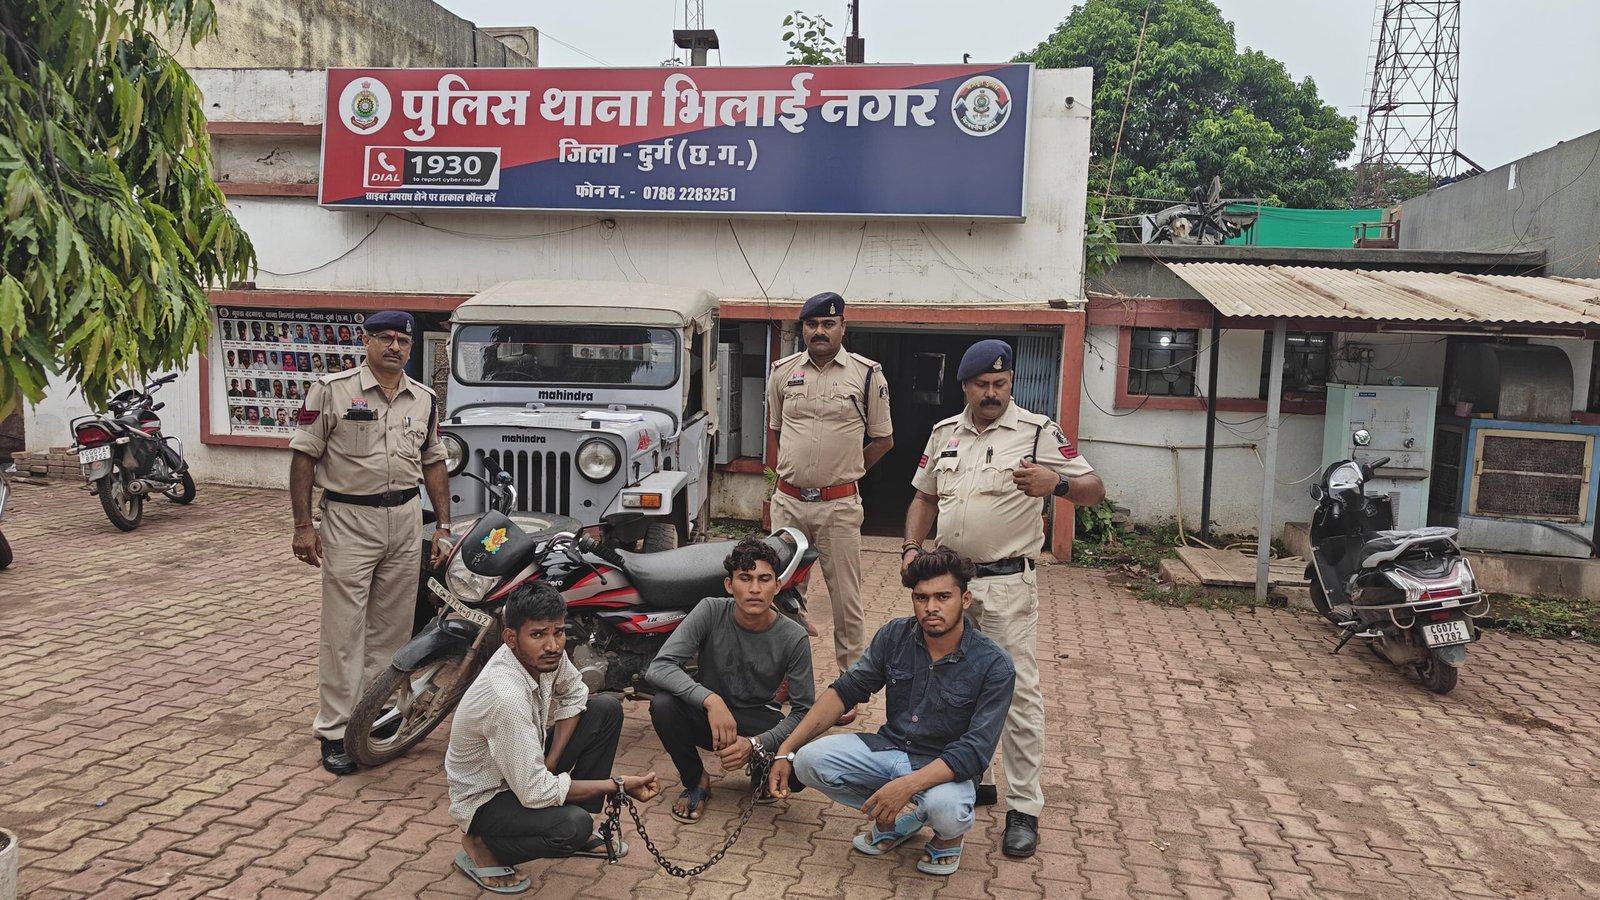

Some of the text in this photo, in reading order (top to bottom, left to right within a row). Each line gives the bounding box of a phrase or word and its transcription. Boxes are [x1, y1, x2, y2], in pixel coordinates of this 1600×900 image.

[402, 72, 940, 142] पुलिस थाना भिलाई नगर
[558, 138, 619, 164] जिला
[638, 138, 674, 172] दुर्ग
[676, 139, 758, 171] (छ.ग.)
[410, 155, 482, 175] 1930
[370, 173, 400, 182] DIAL
[365, 191, 388, 202] साइबर
[388, 192, 413, 201] अपराध
[414, 190, 427, 201] होने
[428, 193, 438, 202] पर
[575, 181, 605, 199] फोन
[643, 186, 675, 201] 0788
[679, 187, 736, 201] 2283251
[538, 389, 593, 401] mahindra
[502, 434, 546, 444] mahindra
[546, 579, 563, 587] ero
[1430, 622, 1460, 634] CG07C
[1433, 631, 1463, 644] R1282
